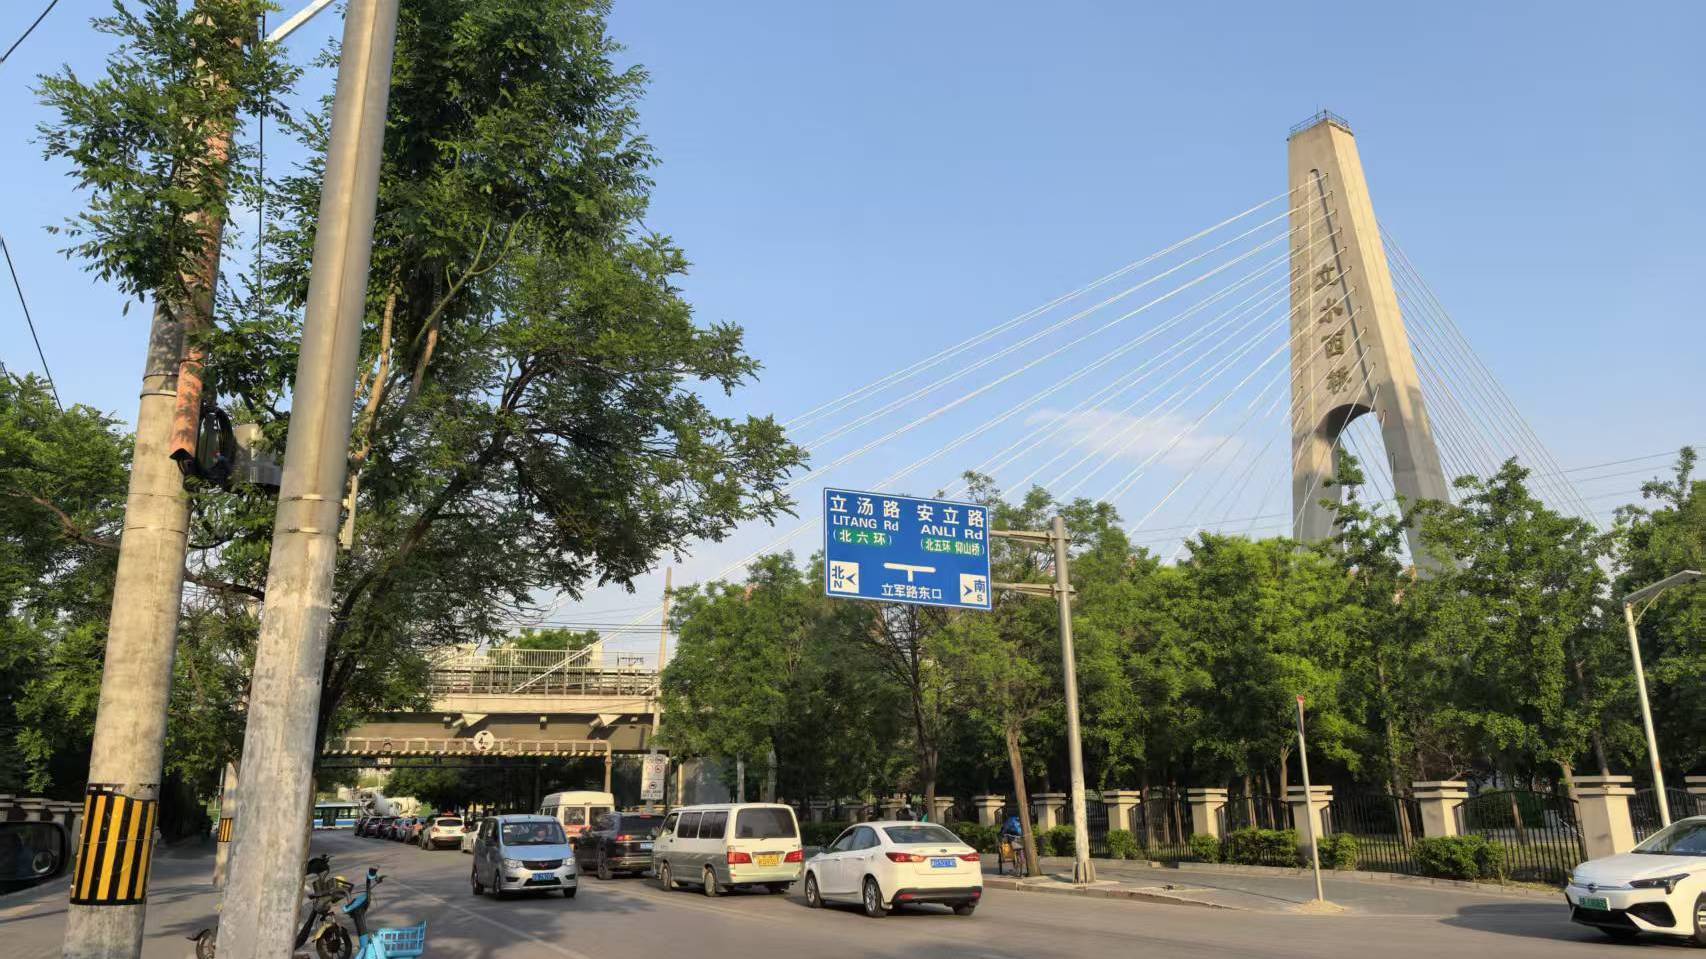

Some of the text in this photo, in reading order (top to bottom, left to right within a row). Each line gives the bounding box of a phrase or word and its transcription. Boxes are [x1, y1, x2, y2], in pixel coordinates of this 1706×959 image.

[830, 494, 900, 518] 立汤路
[833, 515, 899, 532] LITANG Rd
[917, 504, 984, 528] 安立路
[921, 524, 983, 540] ANLI Rd
[832, 565, 845, 580] 北
[834, 580, 843, 588] N
[881, 583, 942, 600] 立军路东口
[974, 579, 986, 594] 南
[977, 594, 983, 602] S
